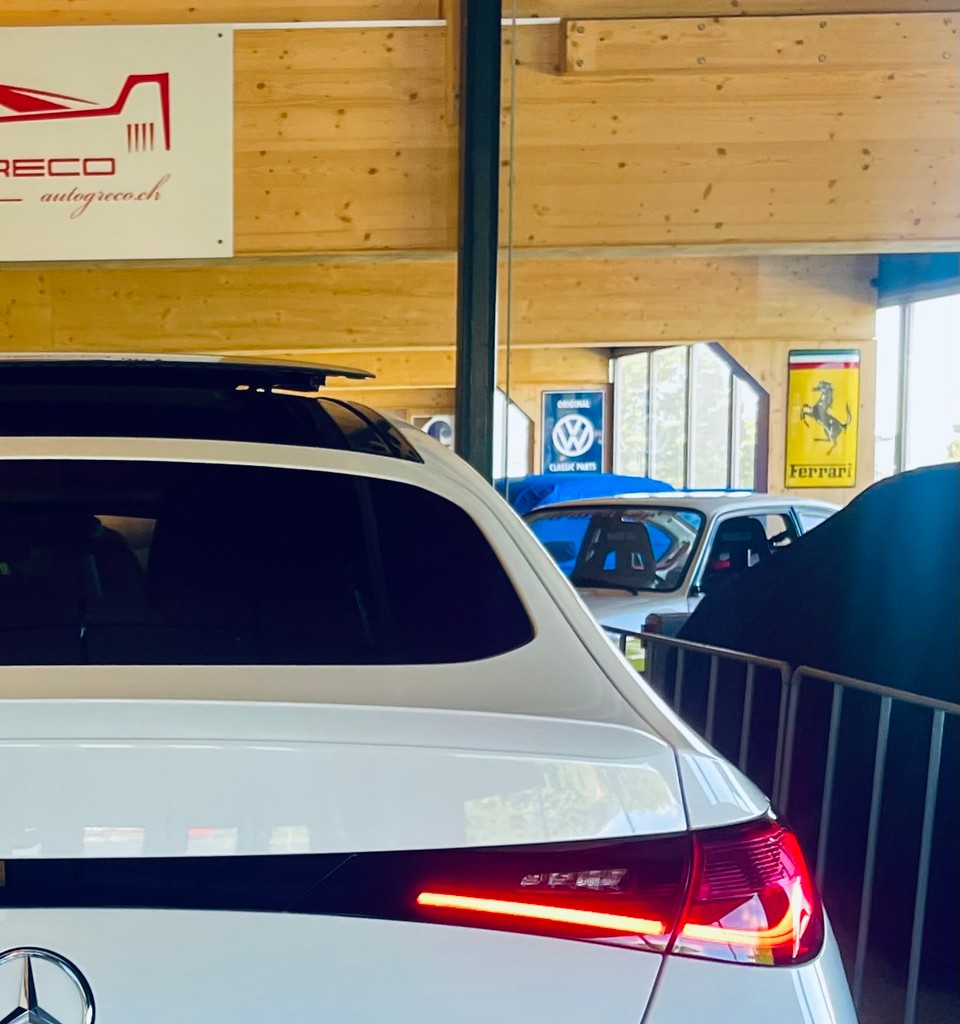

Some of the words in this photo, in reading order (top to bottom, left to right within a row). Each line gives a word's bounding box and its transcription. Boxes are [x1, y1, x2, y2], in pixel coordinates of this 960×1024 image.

[40, 173, 171, 220] autogreco.ch
[557, 400, 590, 409] ORIGINAL
[549, 463, 575, 472] CLASSIC
[576, 462, 597, 471] PARTS
[789, 464, 852, 478] Ferrari
